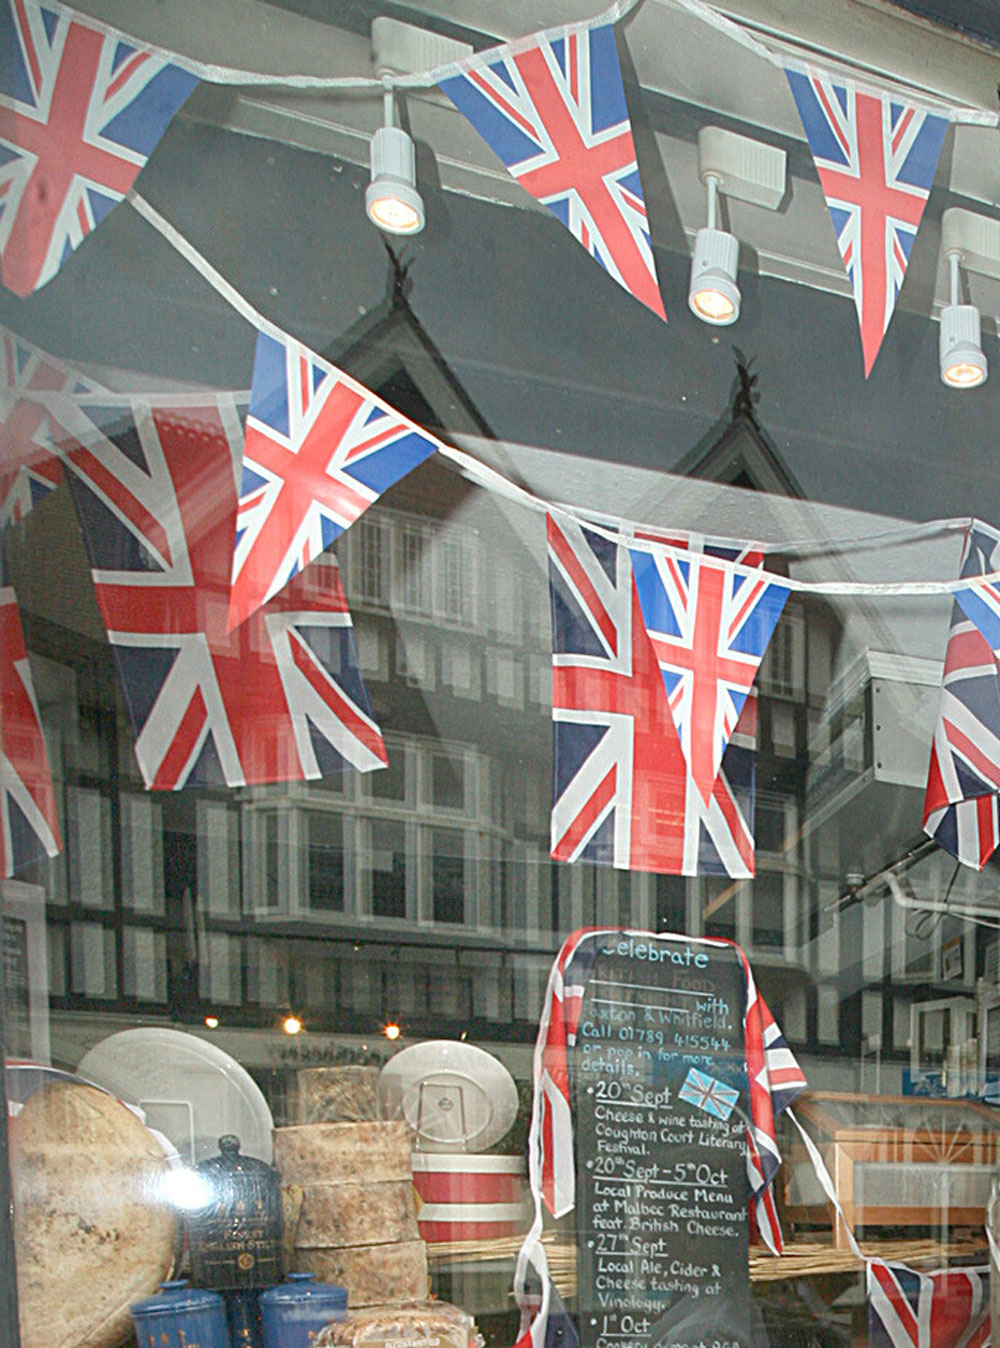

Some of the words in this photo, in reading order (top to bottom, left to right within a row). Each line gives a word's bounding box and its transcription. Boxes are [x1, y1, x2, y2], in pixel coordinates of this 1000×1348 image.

[696, 997, 729, 1015] with
[581, 1021, 611, 1039] Call
[618, 1026, 664, 1044] 01789
[674, 1033, 731, 1052] 415544
[583, 1043, 601, 1055] or
[606, 1046, 631, 1060] pop
[637, 1046, 651, 1060] in
[658, 1047, 679, 1061] for
[682, 1053, 714, 1066] more
[581, 1057, 640, 1077] details.
[630, 1084, 673, 1106] Sept
[595, 1106, 644, 1124] Cheese
[658, 1113, 686, 1127] wine
[689, 1116, 730, 1135] tasting
[732, 1119, 746, 1134] at
[660, 1128, 694, 1144] Court
[623, 1160, 660, 1182] Sept
[696, 1165, 729, 1186] Oct
[594, 1182, 631, 1198] Local
[635, 1184, 689, 1201] Produce
[694, 1188, 733, 1204] Menu
[593, 1201, 610, 1213] at
[614, 1201, 664, 1218] Malbec
[670, 1204, 748, 1222] Restaurant
[629, 1216, 680, 1233] British
[687, 1220, 740, 1237] Cheese.
[630, 1237, 668, 1258] Sept
[598, 1258, 635, 1273] Local
[670, 1262, 707, 1278] Cider
[596, 1275, 647, 1291] Cheese
[650, 1277, 699, 1298] tasting
[705, 1283, 722, 1295] at
[620, 1316, 650, 1334] Oct
